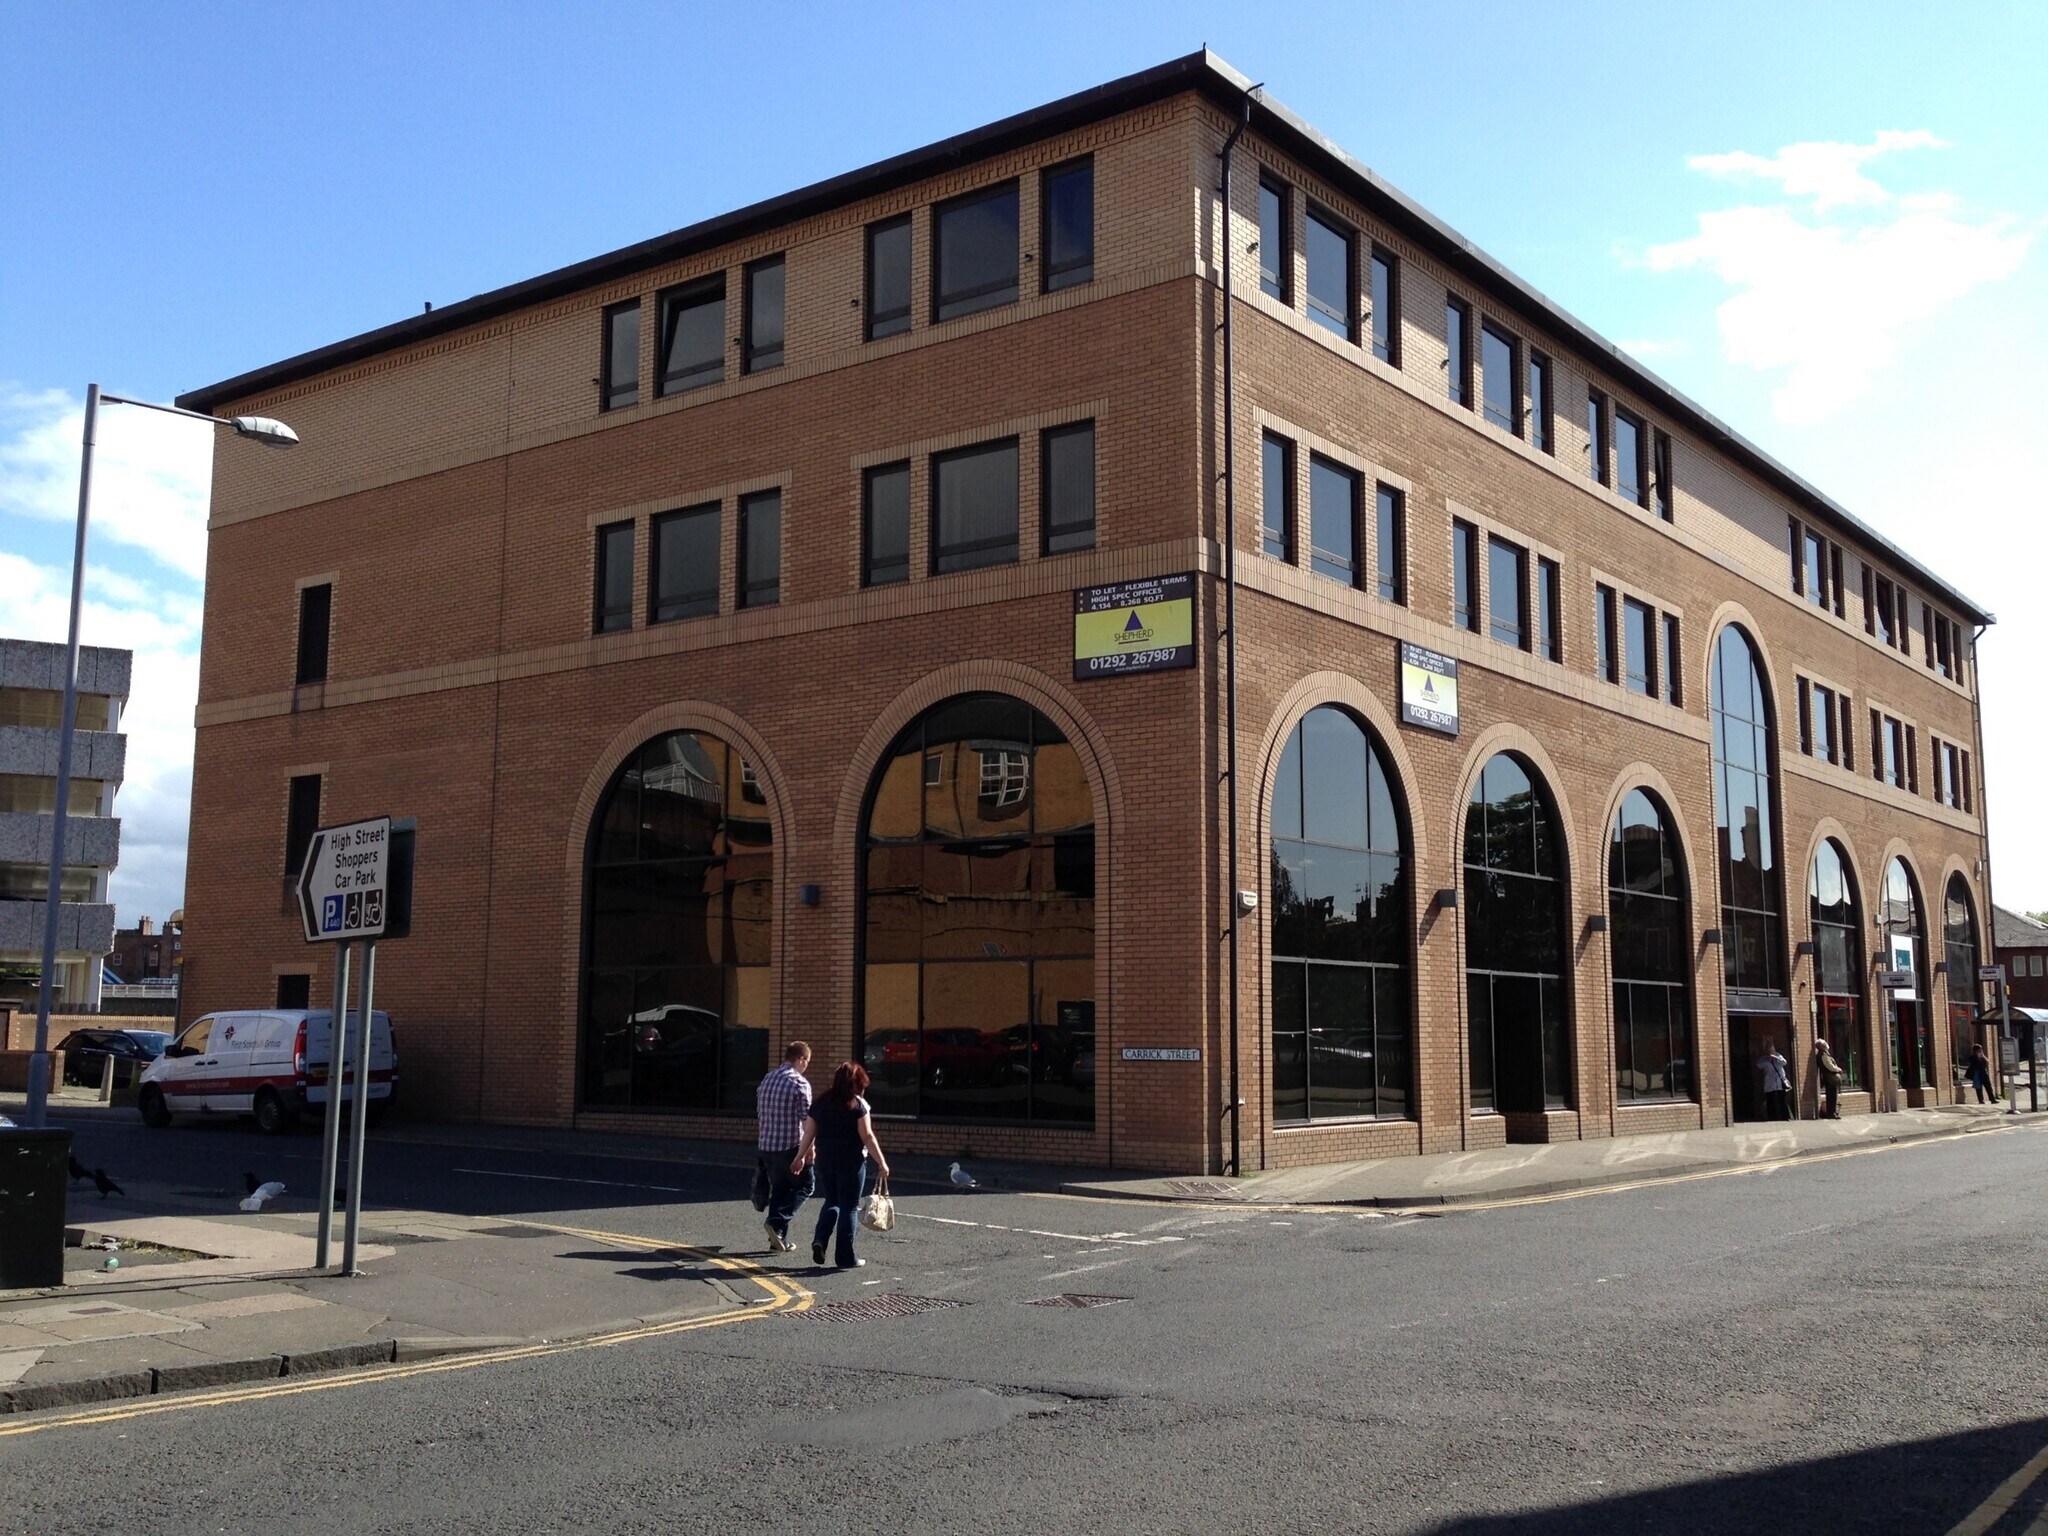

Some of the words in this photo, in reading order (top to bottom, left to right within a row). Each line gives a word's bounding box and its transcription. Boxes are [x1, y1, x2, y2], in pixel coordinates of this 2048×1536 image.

[1104, 586, 1116, 594] LET
[1125, 580, 1158, 591] FLEXIBLE
[1160, 576, 1188, 586] TERMS
[1091, 595, 1110, 604] HIGH
[1112, 592, 1130, 601] SPEC
[1132, 587, 1162, 598] OFFICES
[1114, 628, 1154, 642] SHEPHERD
[1090, 655, 1126, 670] 01292
[1132, 648, 1176, 665] 267987
[1410, 705, 1429, 720] 01292
[1430, 711, 1452, 726] 267987
[330, 832, 351, 852] High
[355, 826, 385, 845] Street
[335, 850, 378, 869] Shoppers
[335, 873, 351, 888] Car
[355, 869, 376, 886] Park
[325, 900, 336, 929] P
[1125, 1049, 1162, 1059] CARRICK
[1166, 1050, 1197, 1059] STREET
